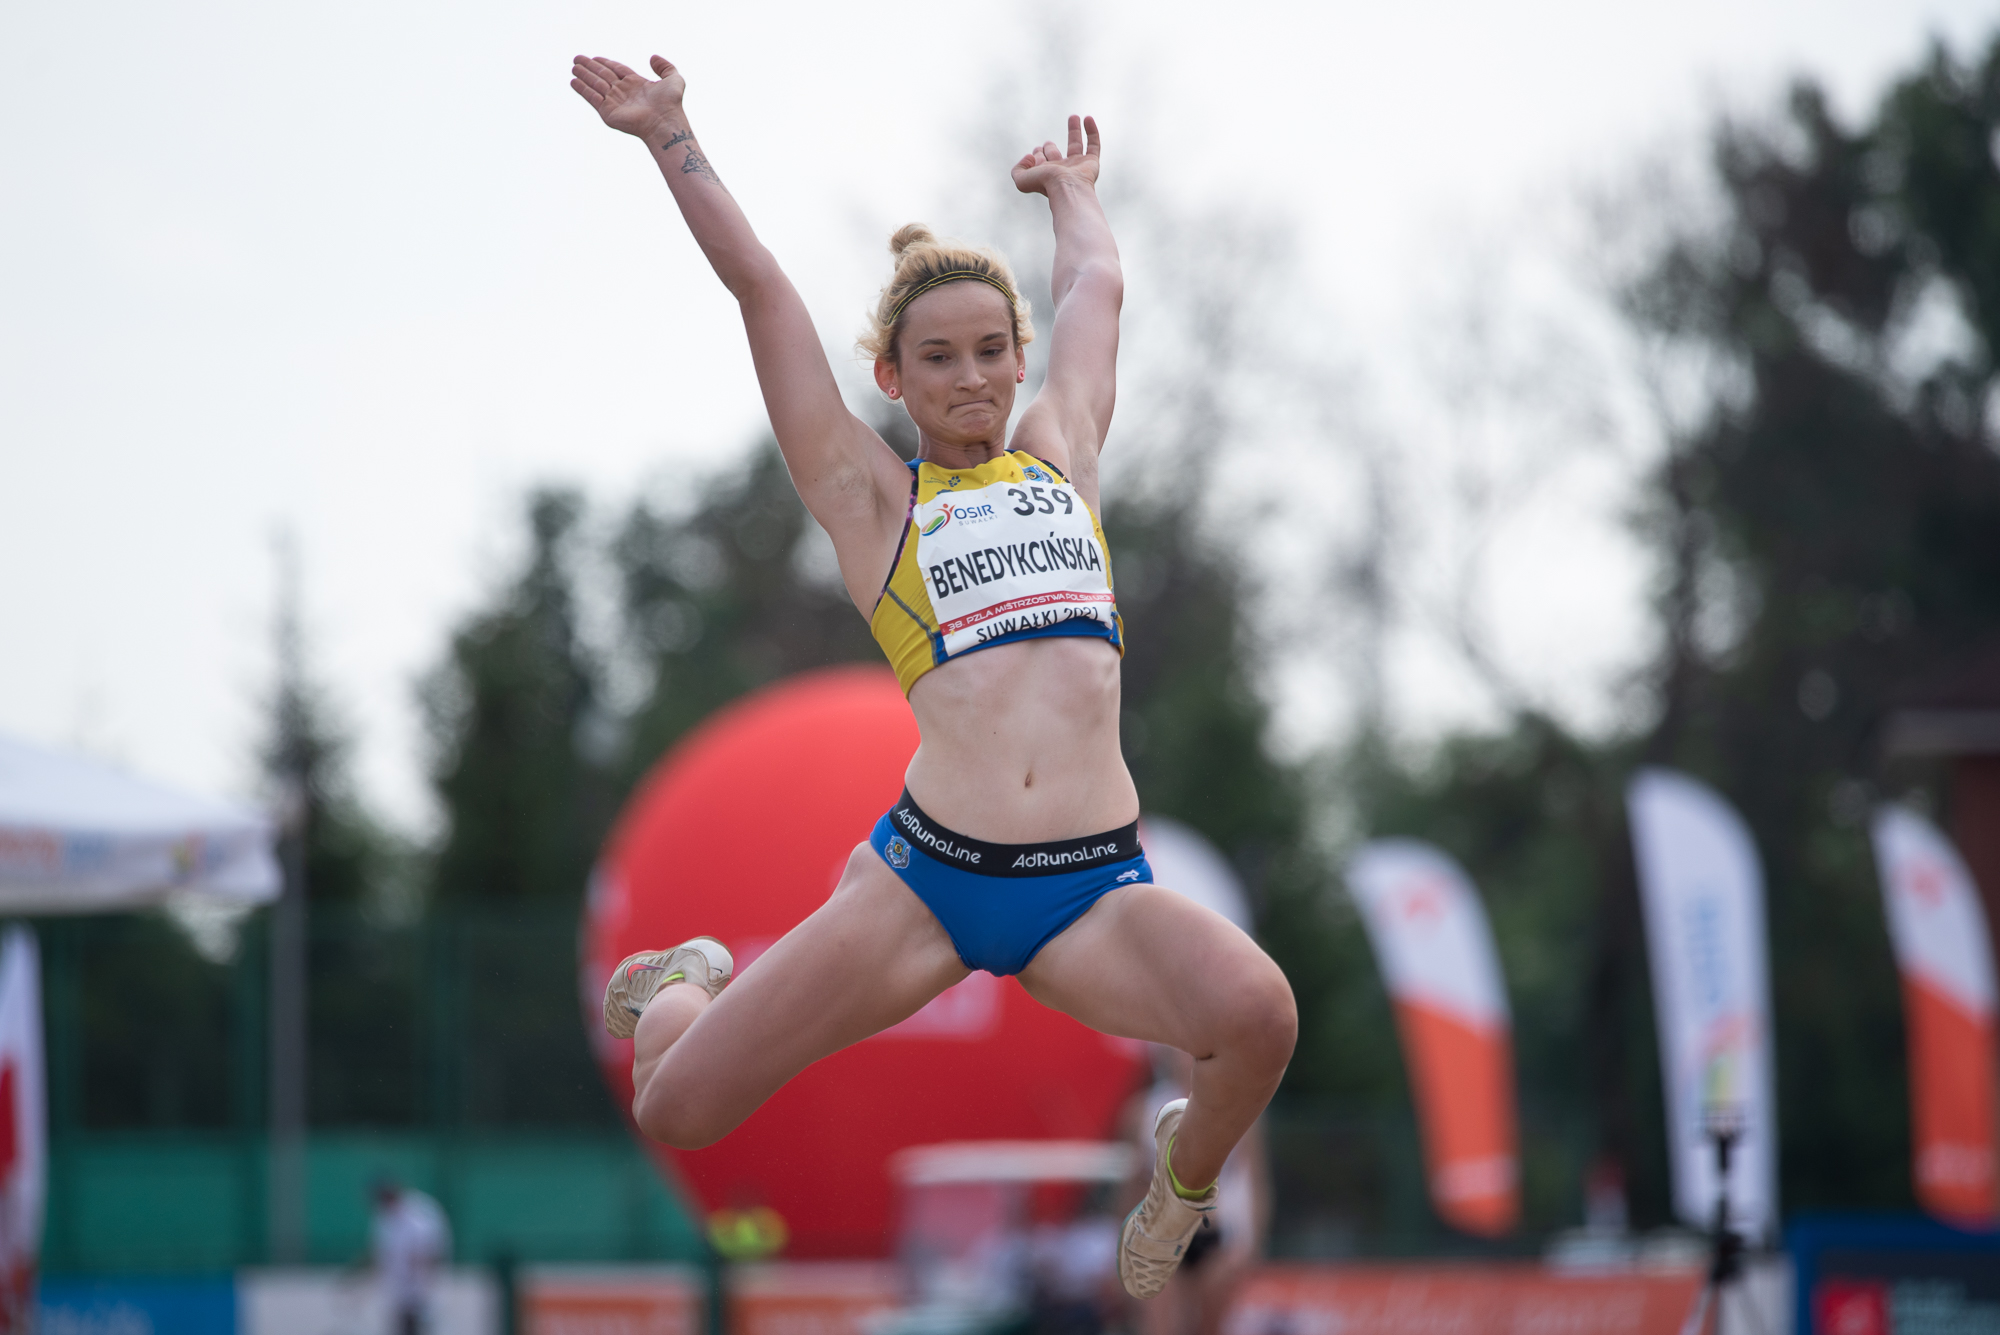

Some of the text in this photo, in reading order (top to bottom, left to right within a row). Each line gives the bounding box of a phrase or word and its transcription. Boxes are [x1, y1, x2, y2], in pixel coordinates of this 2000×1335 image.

[954, 504, 995, 519] OSIR
[1007, 486, 1073, 516] 359
[958, 514, 998, 526] SUWAŁKI
[929, 531, 1102, 599] BENEDYKCIŃSKA
[966, 610, 994, 624] PZLA
[995, 593, 1066, 614] MISTRZOSTWA
[1065, 593, 1092, 601] POLSKI
[976, 609, 1058, 643] SUWAŁKI
